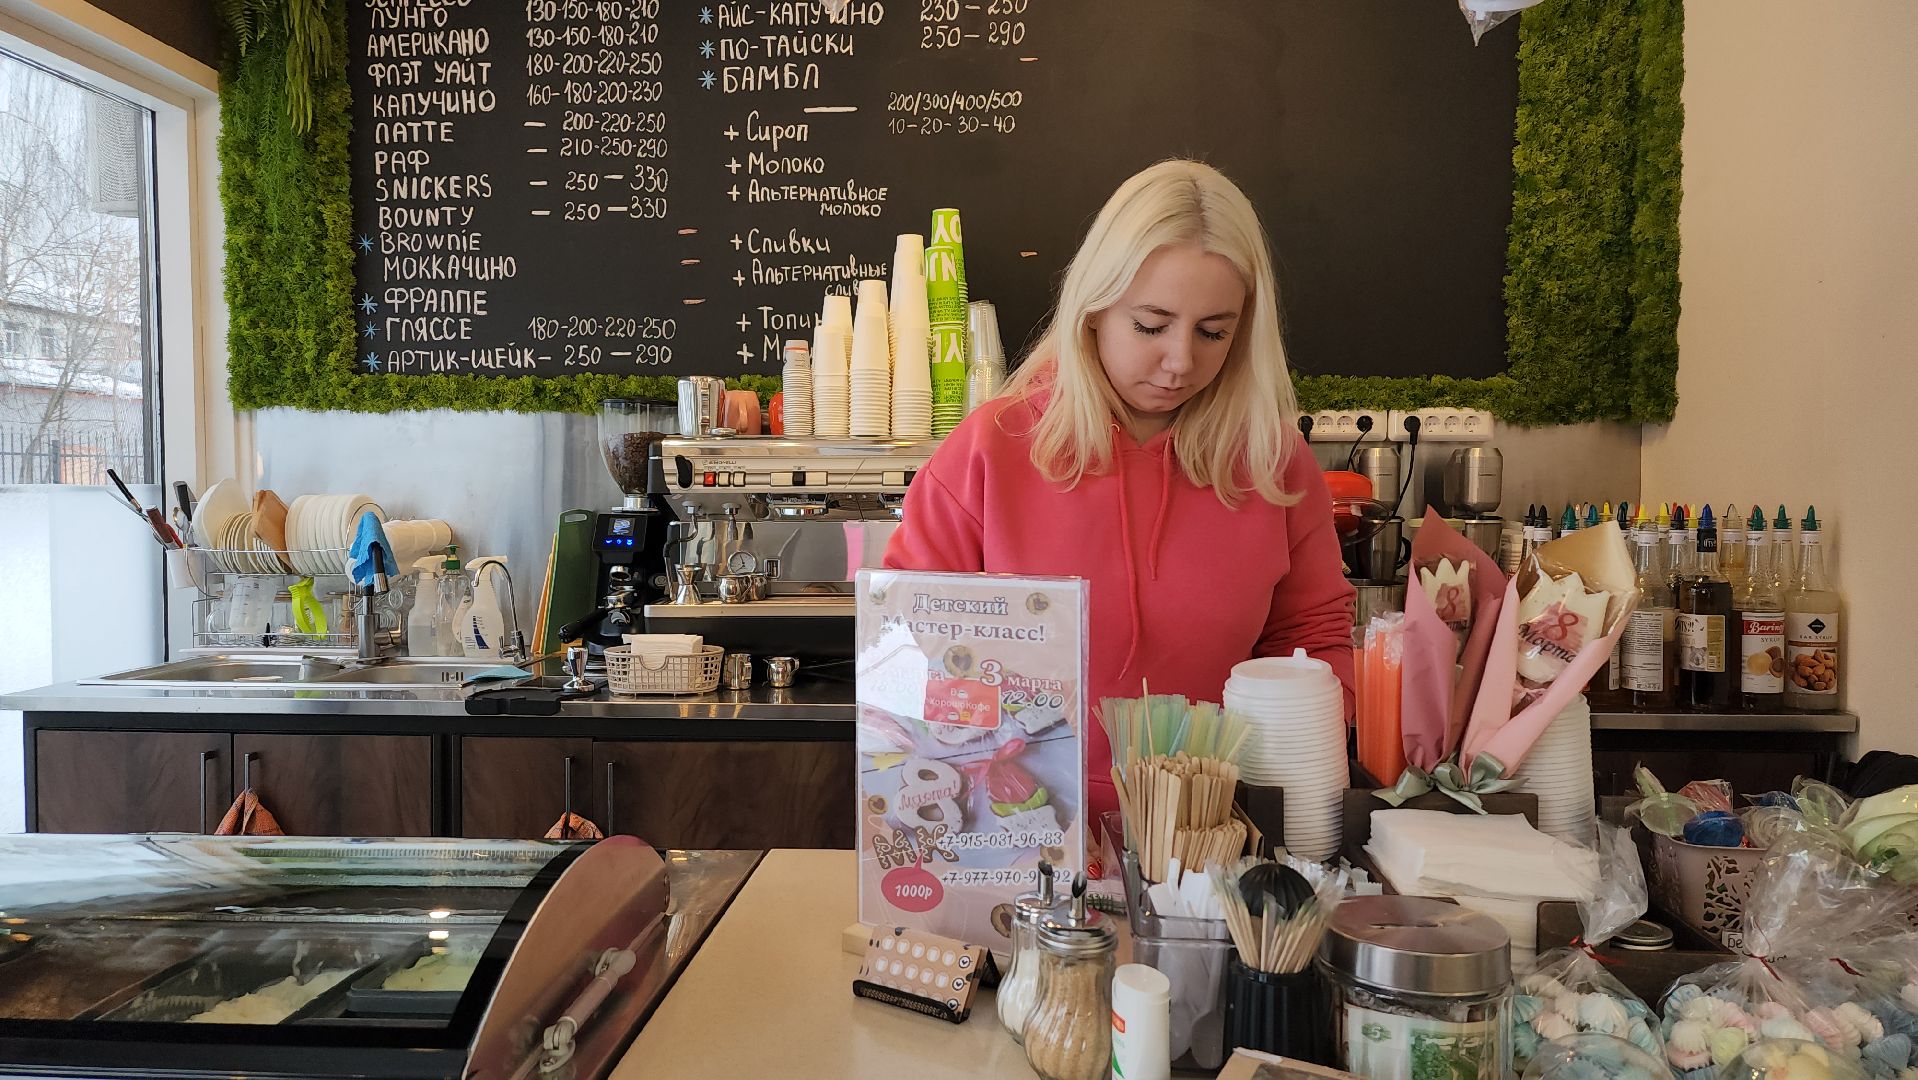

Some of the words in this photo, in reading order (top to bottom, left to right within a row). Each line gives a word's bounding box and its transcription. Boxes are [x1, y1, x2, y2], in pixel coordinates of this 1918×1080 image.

[371, 7, 448, 29] ЛУНГО
[367, 27, 490, 58] АМЕРИКАНО
[720, 30, 854, 61] ПО-ТАЙСКИ
[367, 61, 422, 87] ФЛЭТ
[434, 57, 492, 86] УАЙТ
[723, 62, 819, 94] БАМБЛ
[373, 89, 496, 118] КАПУЧИНО
[888, 89, 1023, 115] 200/300/400/500
[375, 121, 455, 144] ЛАТТЕ
[562, 111, 666, 133] 200-220-250
[746, 110, 808, 152] Сироп
[560, 137, 668, 158] 210-250-290
[375, 150, 430, 175] РАФ
[748, 152, 825, 175] Молоко
[376, 173, 493, 200] SNICKERS
[565, 171, 599, 191] 250
[630, 165, 669, 193] 330
[379, 205, 475, 230] BOUNTY
[564, 201, 600, 221] 250
[629, 196, 667, 220] 330
[747, 228, 831, 254] Сливки
[384, 255, 517, 283] МОККАЧИНО
[385, 287, 488, 315] ФРАППЕ
[386, 317, 473, 342] ГЛЯССЕ
[528, 316, 677, 341] 180-200-220-250
[564, 344, 602, 366] 250
[635, 343, 673, 365] 290
[912, 593, 1009, 616] Детский
[1543, 612, 1579, 642] 8
[979, 658, 1003, 687] 3
[1007, 675, 1063, 695] марта
[1002, 690, 1064, 709] 12.00
